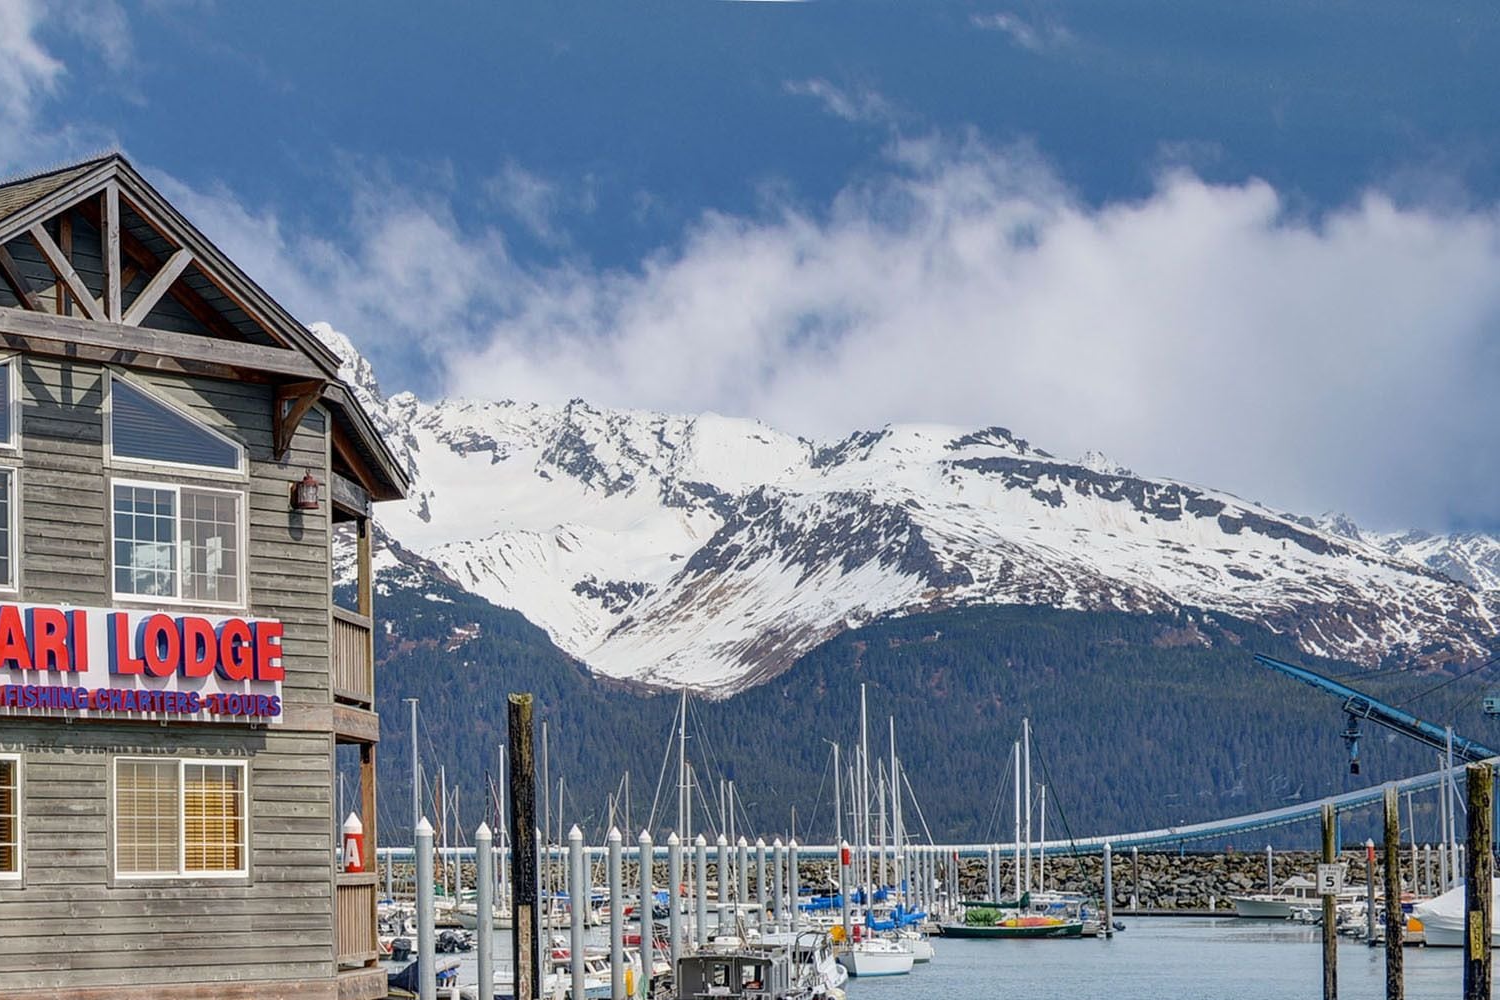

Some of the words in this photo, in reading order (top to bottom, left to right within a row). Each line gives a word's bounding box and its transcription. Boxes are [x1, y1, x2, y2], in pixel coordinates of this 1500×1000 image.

[107, 611, 286, 682] LODGE
[0, 684, 89, 710] FISHING
[91, 687, 200, 714] CHARTERS
[213, 692, 282, 717] TOURS
[344, 838, 361, 867] A
[1325, 876, 1335, 888] 5
